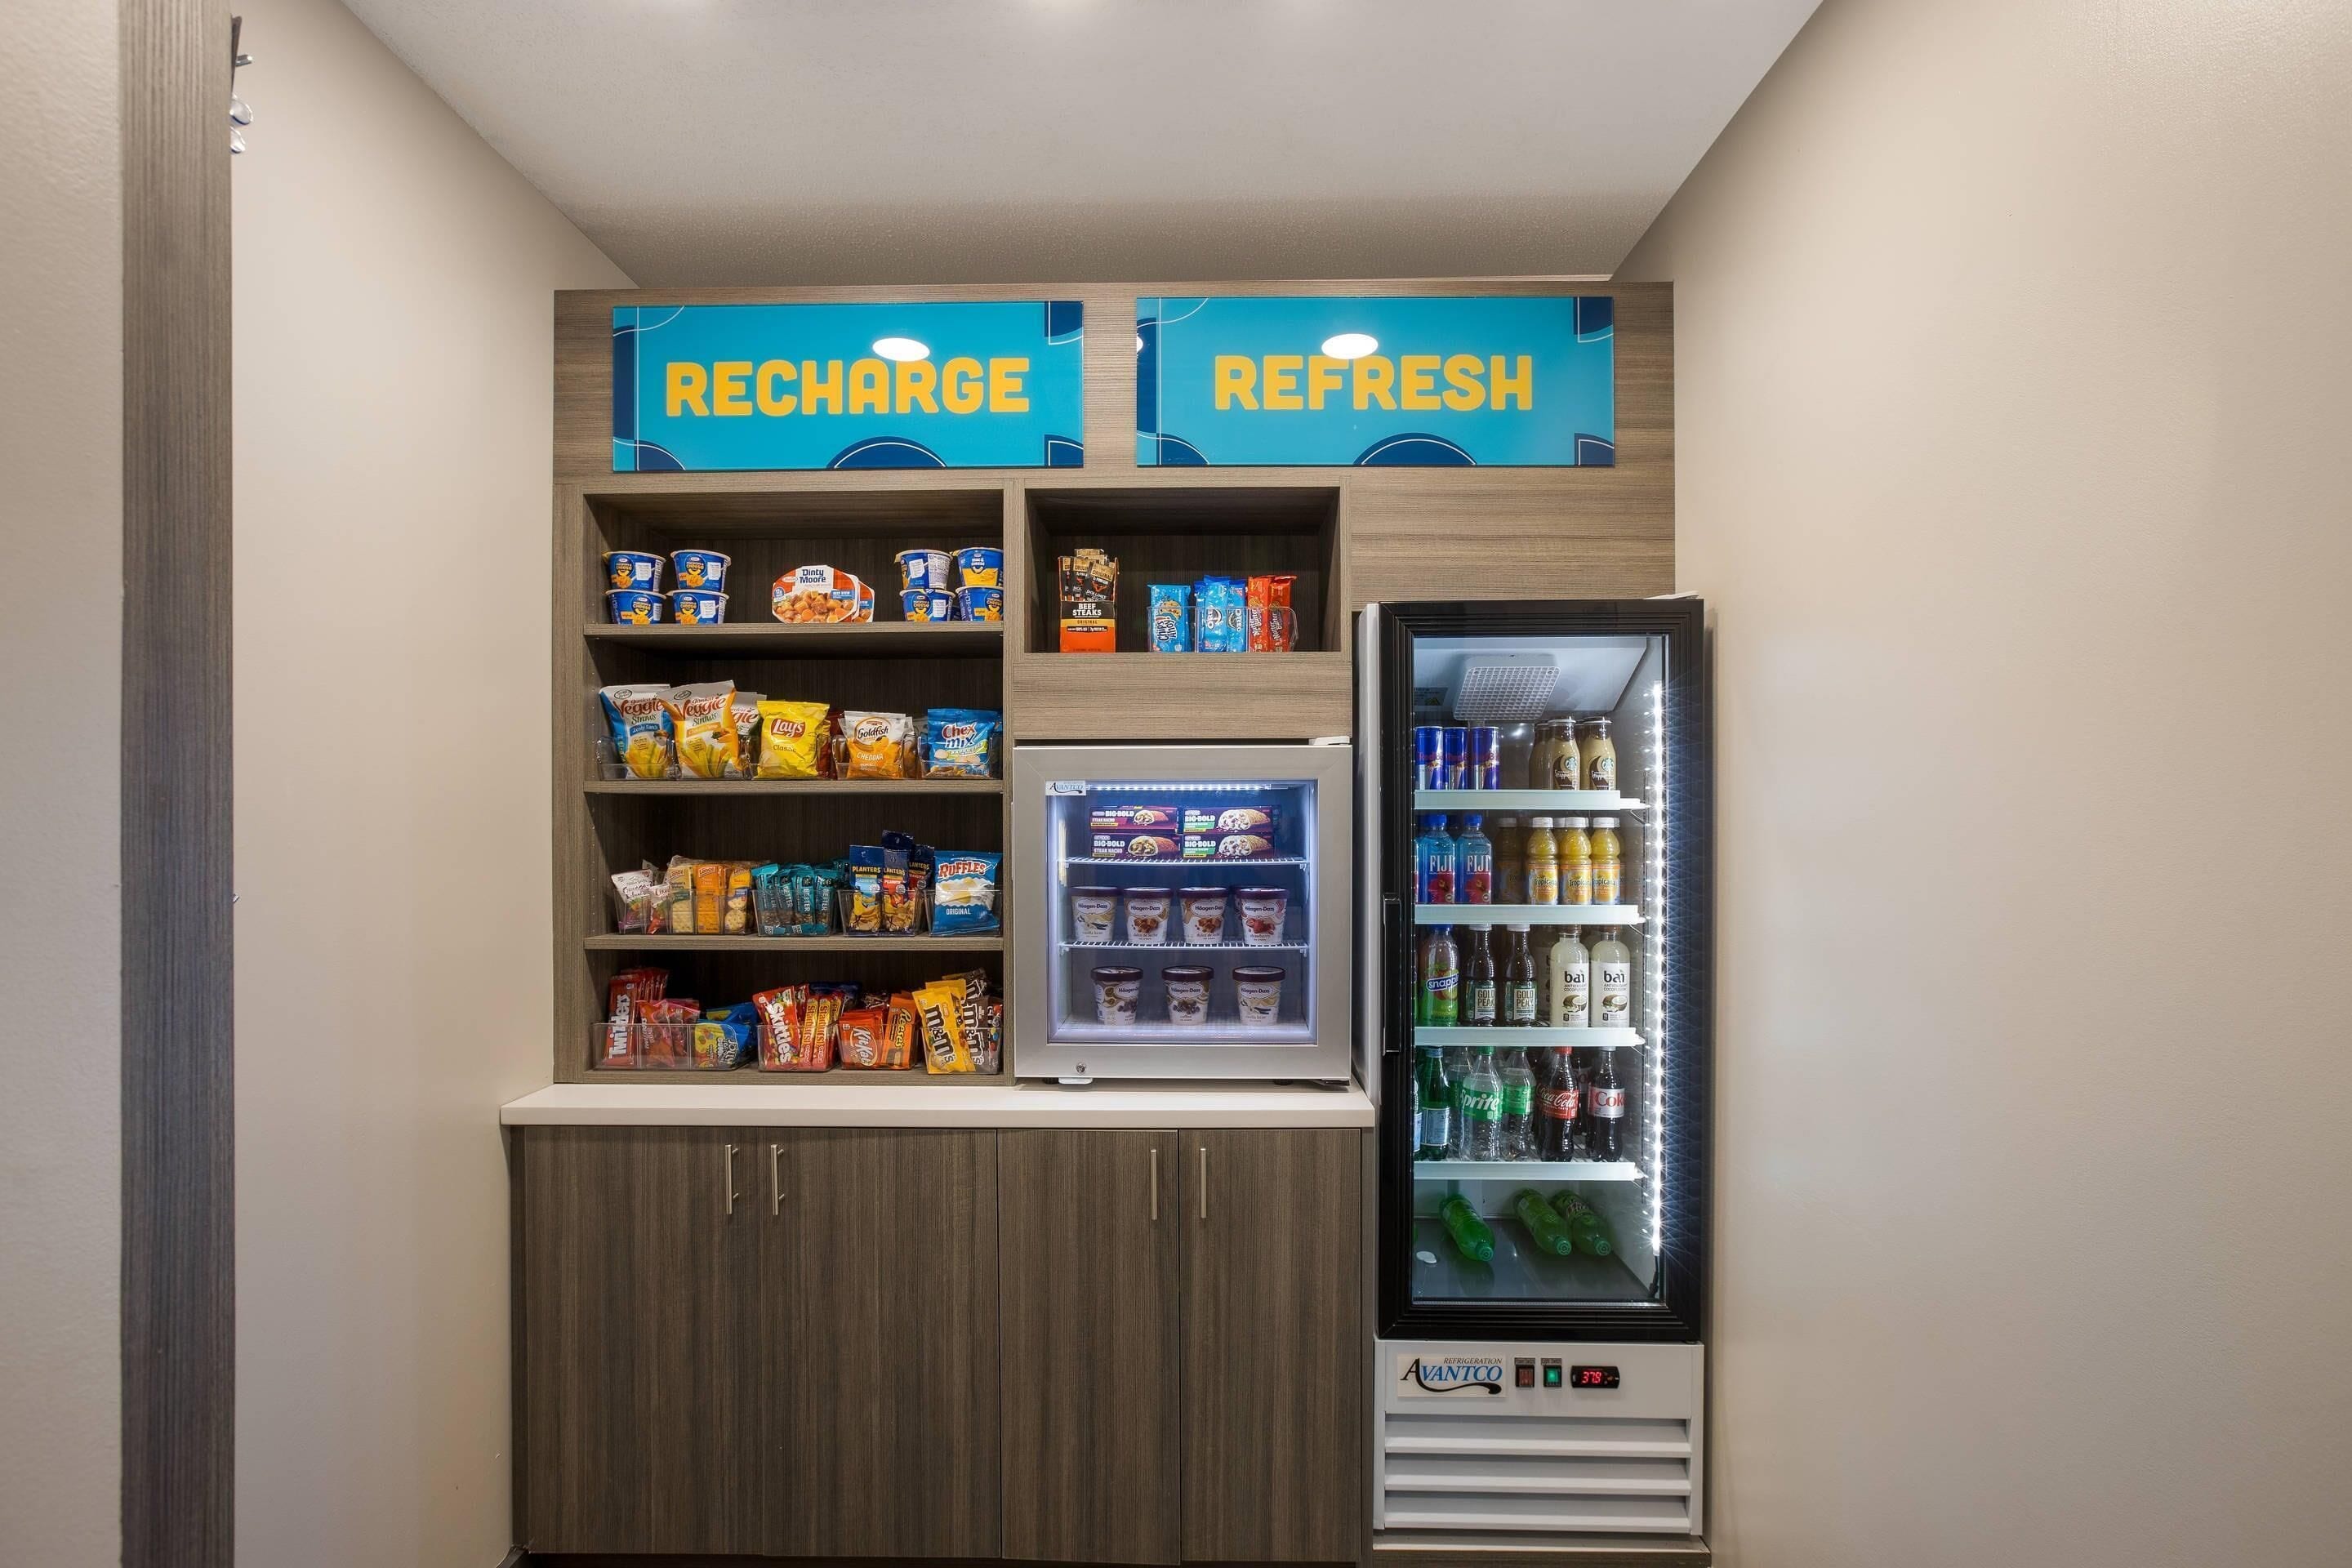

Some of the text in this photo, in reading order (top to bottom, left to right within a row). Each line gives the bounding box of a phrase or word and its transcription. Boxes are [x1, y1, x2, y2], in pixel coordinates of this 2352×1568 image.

[666, 357, 1029, 417] RECHARGE
[1214, 354, 1533, 412] REFRESH
[802, 568, 824, 577] Dinty
[1156, 621, 1169, 641] Chips
[613, 700, 664, 718] Veggie
[674, 697, 727, 720] Veggie
[631, 715, 657, 725] Straws
[693, 712, 718, 726] Straws
[773, 718, 804, 738] Lay's
[858, 725, 889, 739] Goldfish
[942, 722, 977, 739] Chex
[857, 751, 884, 761] CHEDDAR
[852, 866, 881, 874] PLANTERS
[909, 862, 929, 870] LANTERS
[938, 860, 987, 879] RUFFLES
[1430, 855, 1454, 872] FIJI
[1467, 855, 1490, 872] FIJI
[883, 867, 905, 876] LANTERS
[1569, 879, 1591, 889] Tropica
[1428, 973, 1459, 990] snapp
[1564, 969, 1585, 983] bai
[1603, 969, 1624, 983] bai
[1477, 989, 1495, 997] GOLD
[1477, 999, 1495, 1007] PEAK
[1517, 999, 1534, 1007] PEAK
[772, 1002, 792, 1064] Skittles
[895, 1007, 912, 1049] Reese's
[1595, 1091, 1625, 1107] Cok
[1443, 1356, 1503, 1365] REFRIGERATION
[1399, 1356, 1503, 1386] AVANTCO
